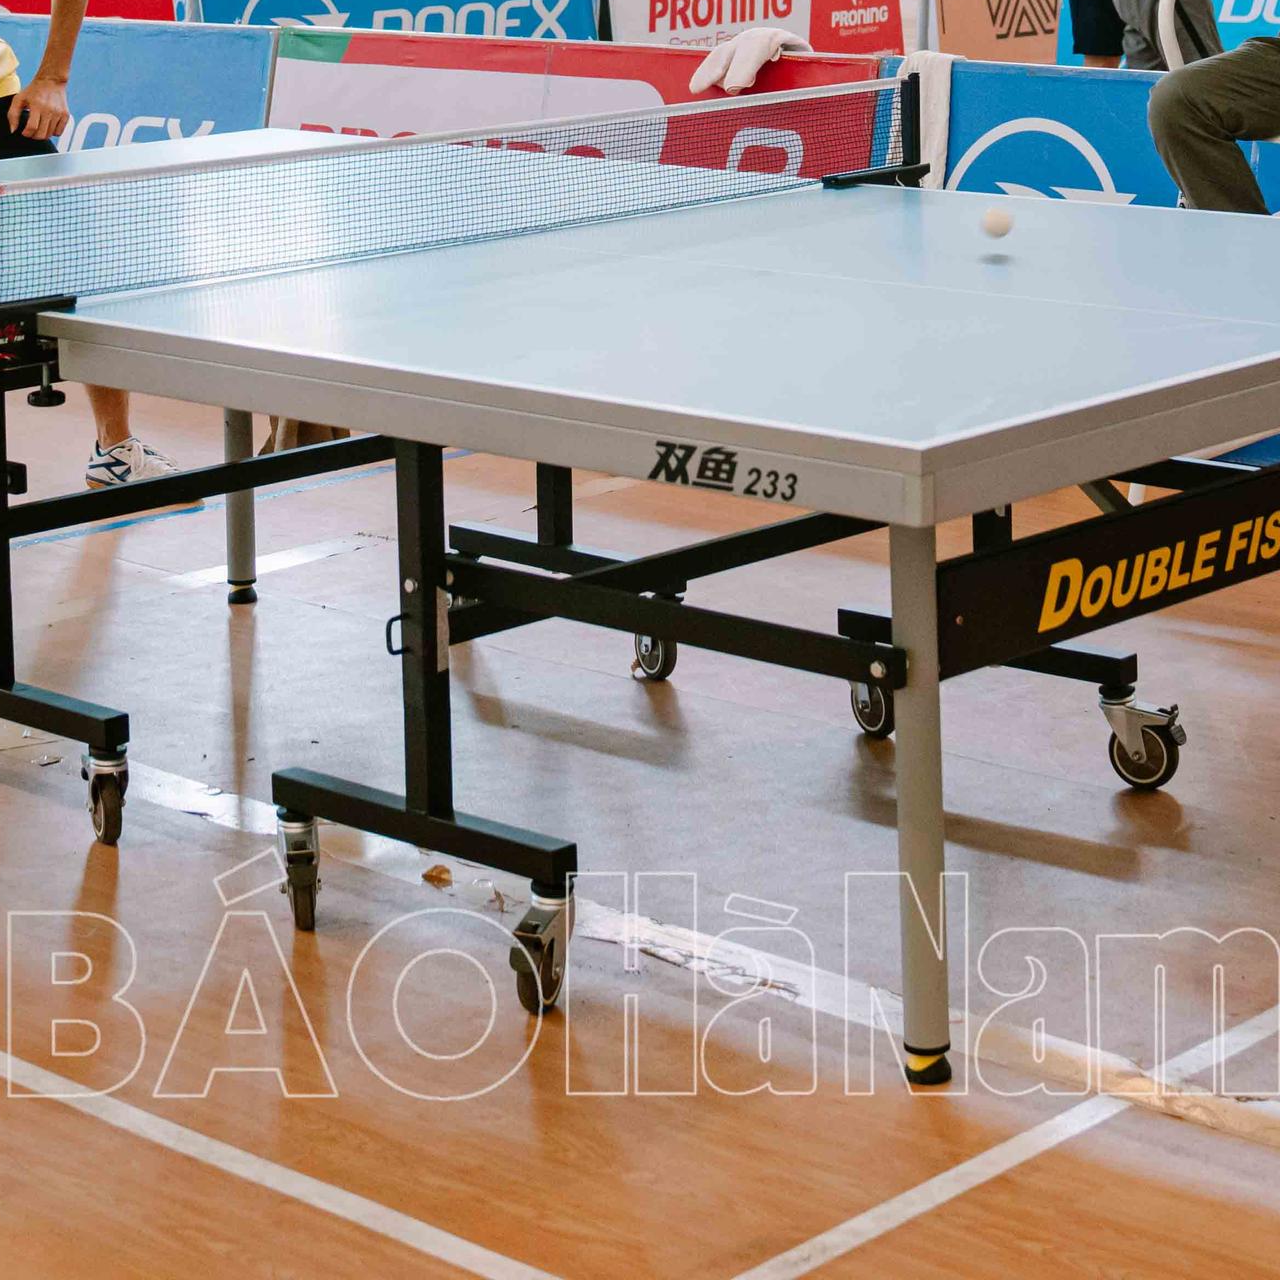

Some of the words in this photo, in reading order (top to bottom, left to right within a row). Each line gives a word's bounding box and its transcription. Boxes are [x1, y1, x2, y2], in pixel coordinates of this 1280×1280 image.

[831, 5, 889, 28] PRONING
[647, 439, 739, 492] 双鱼
[742, 467, 799, 502] 233
[1037, 528, 1219, 635] DOUBLE
